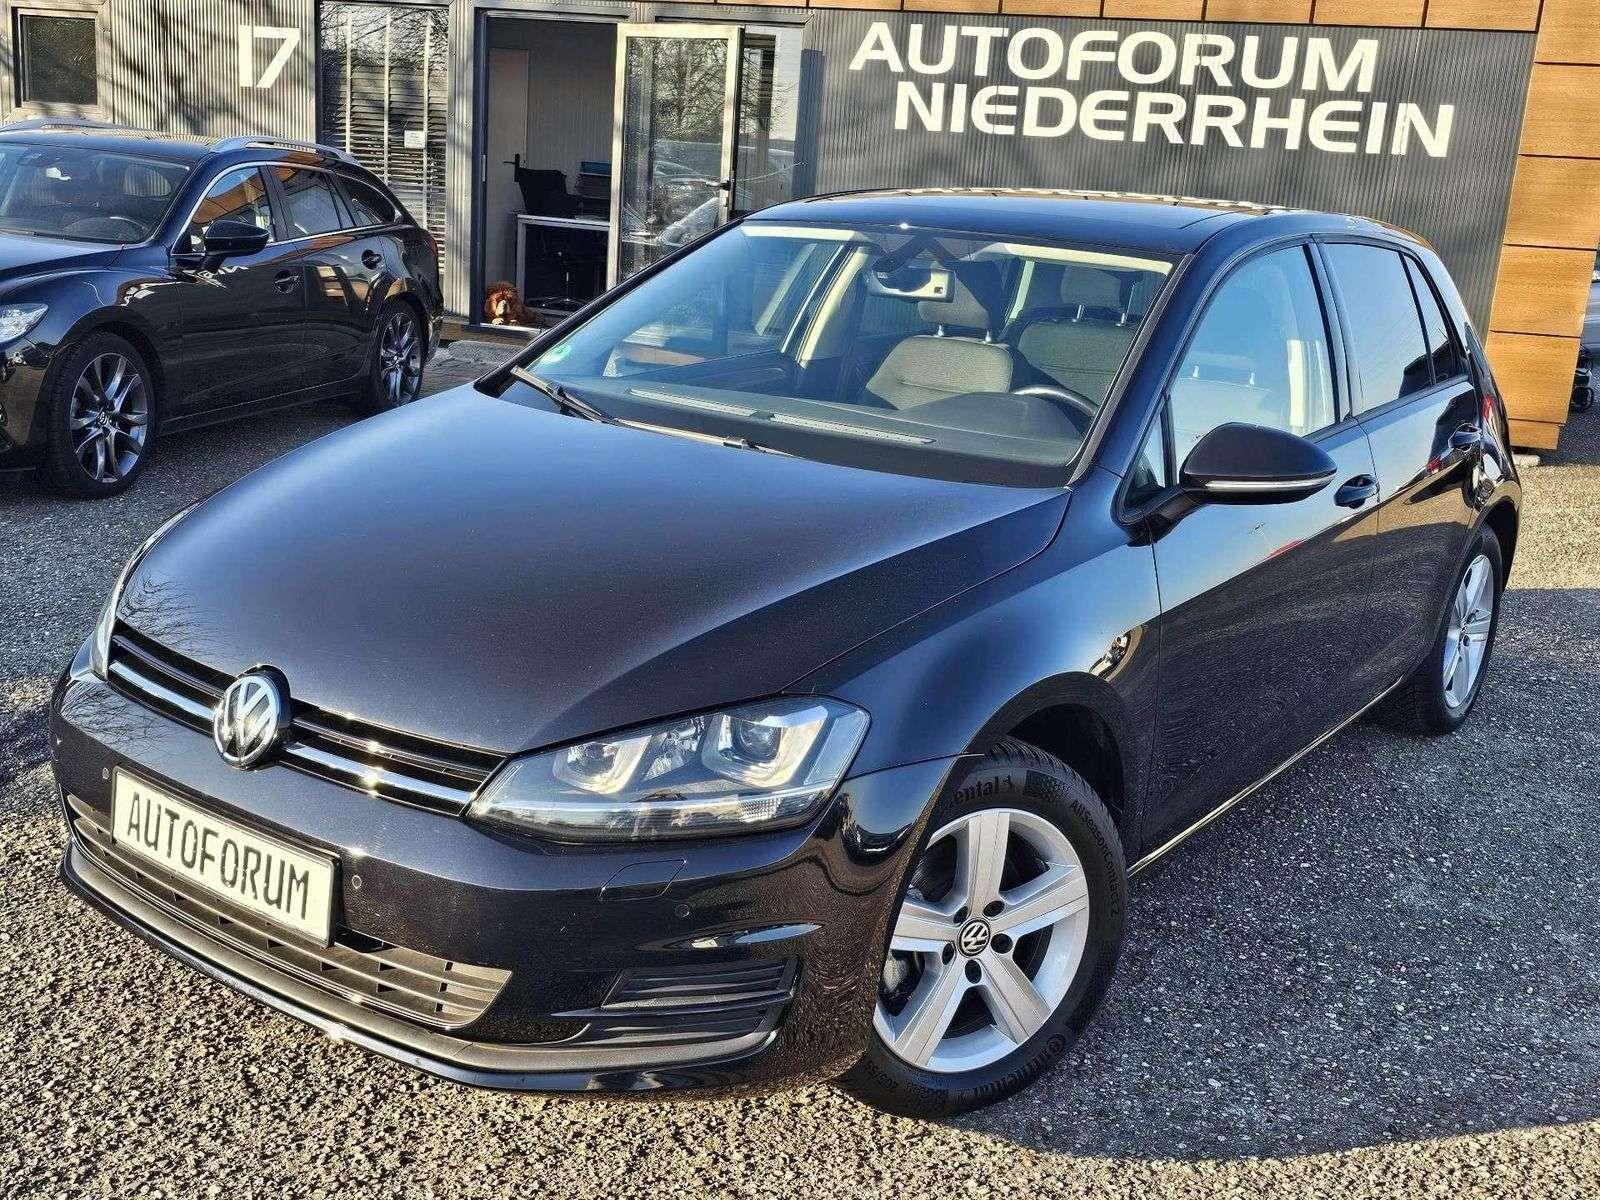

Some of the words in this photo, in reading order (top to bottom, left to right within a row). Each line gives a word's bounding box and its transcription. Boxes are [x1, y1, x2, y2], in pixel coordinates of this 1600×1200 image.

[239, 25, 300, 89] 17
[849, 22, 1378, 93] AUTOFORUM
[893, 81, 1454, 158] NIEDERRHEIN
[127, 792, 310, 920] AUTOFORUM
